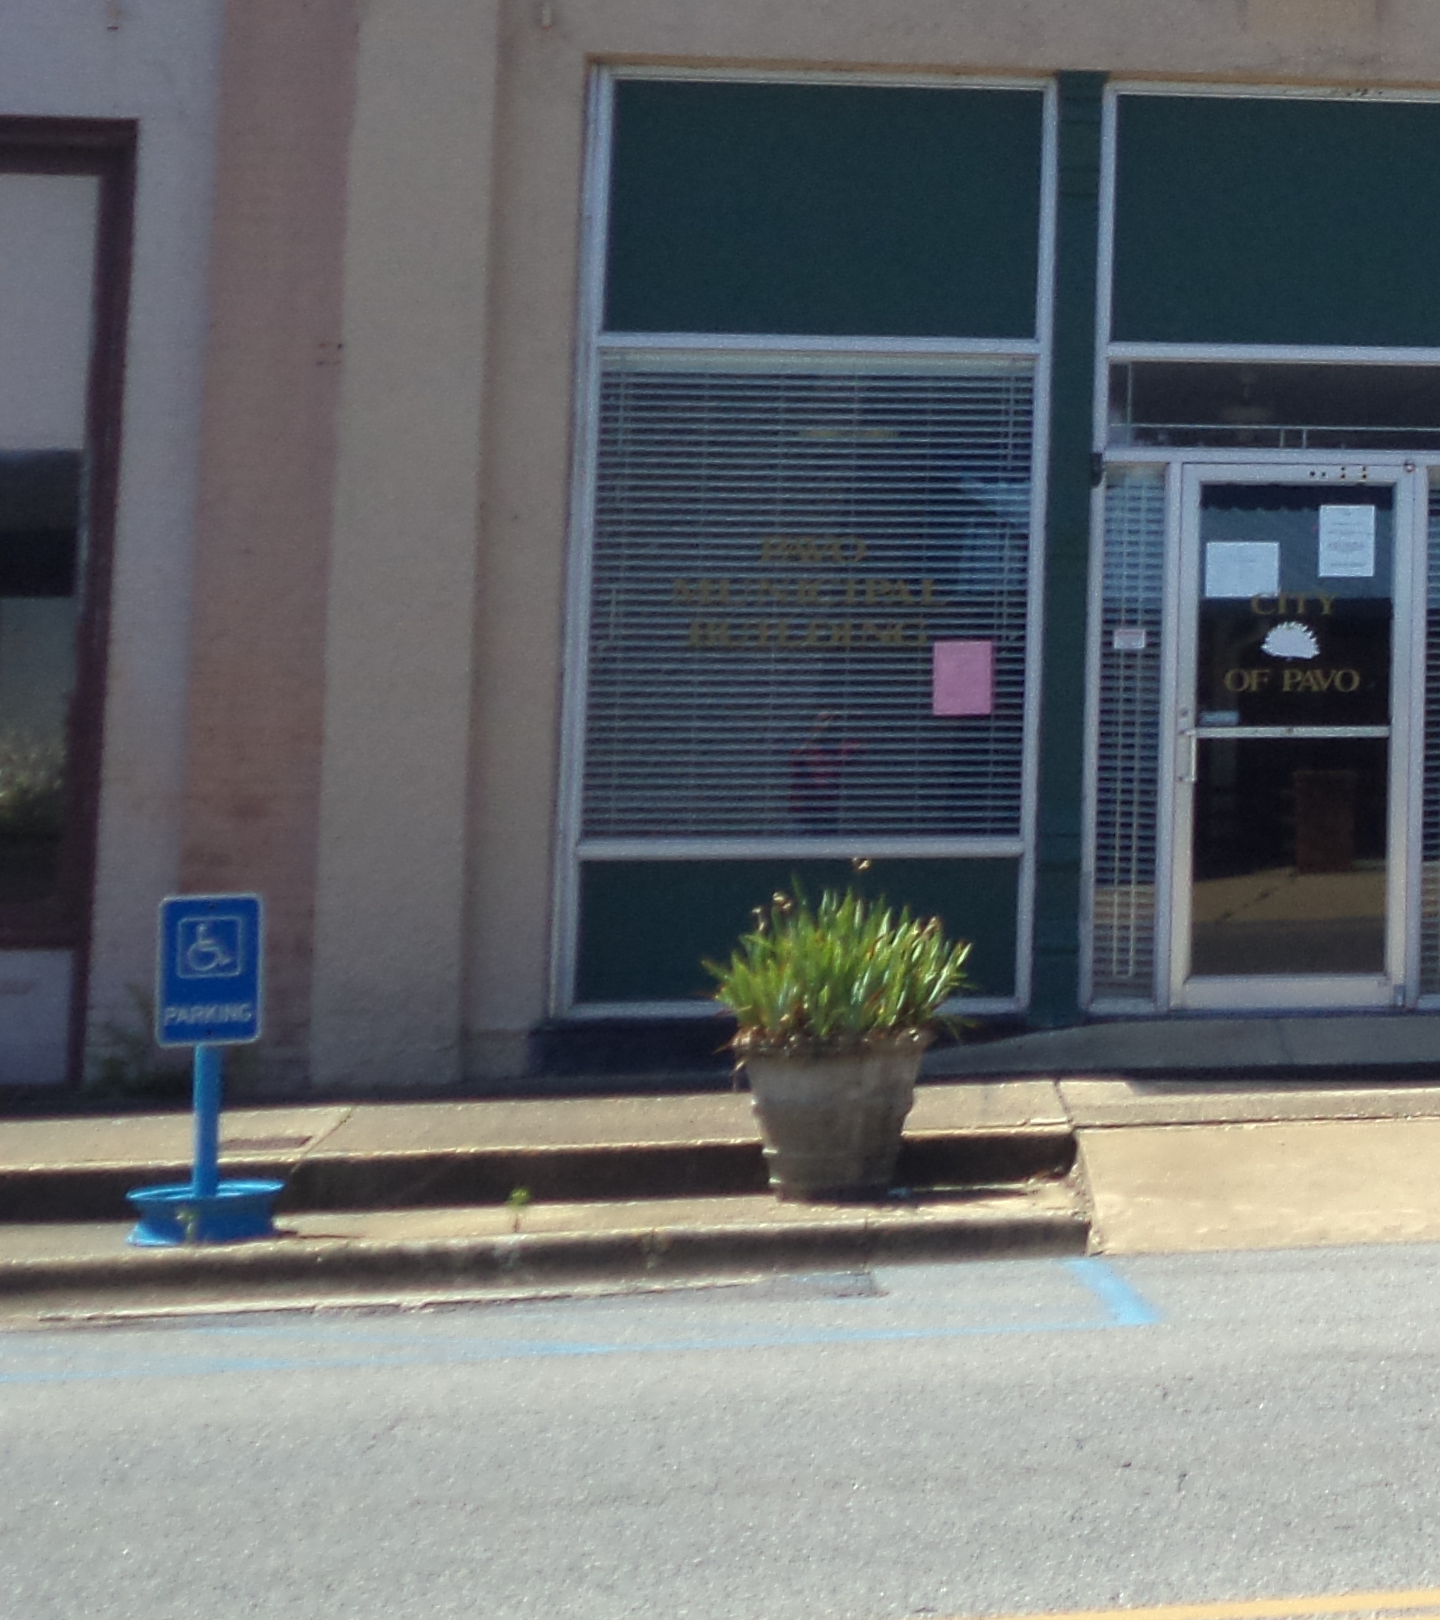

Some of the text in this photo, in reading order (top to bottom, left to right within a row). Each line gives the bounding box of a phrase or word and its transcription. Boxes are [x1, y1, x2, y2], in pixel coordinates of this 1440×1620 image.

[1251, 591, 1341, 616] CITY
[1223, 669, 1361, 693] OF PAVO
[163, 1002, 252, 1026] PARKING
